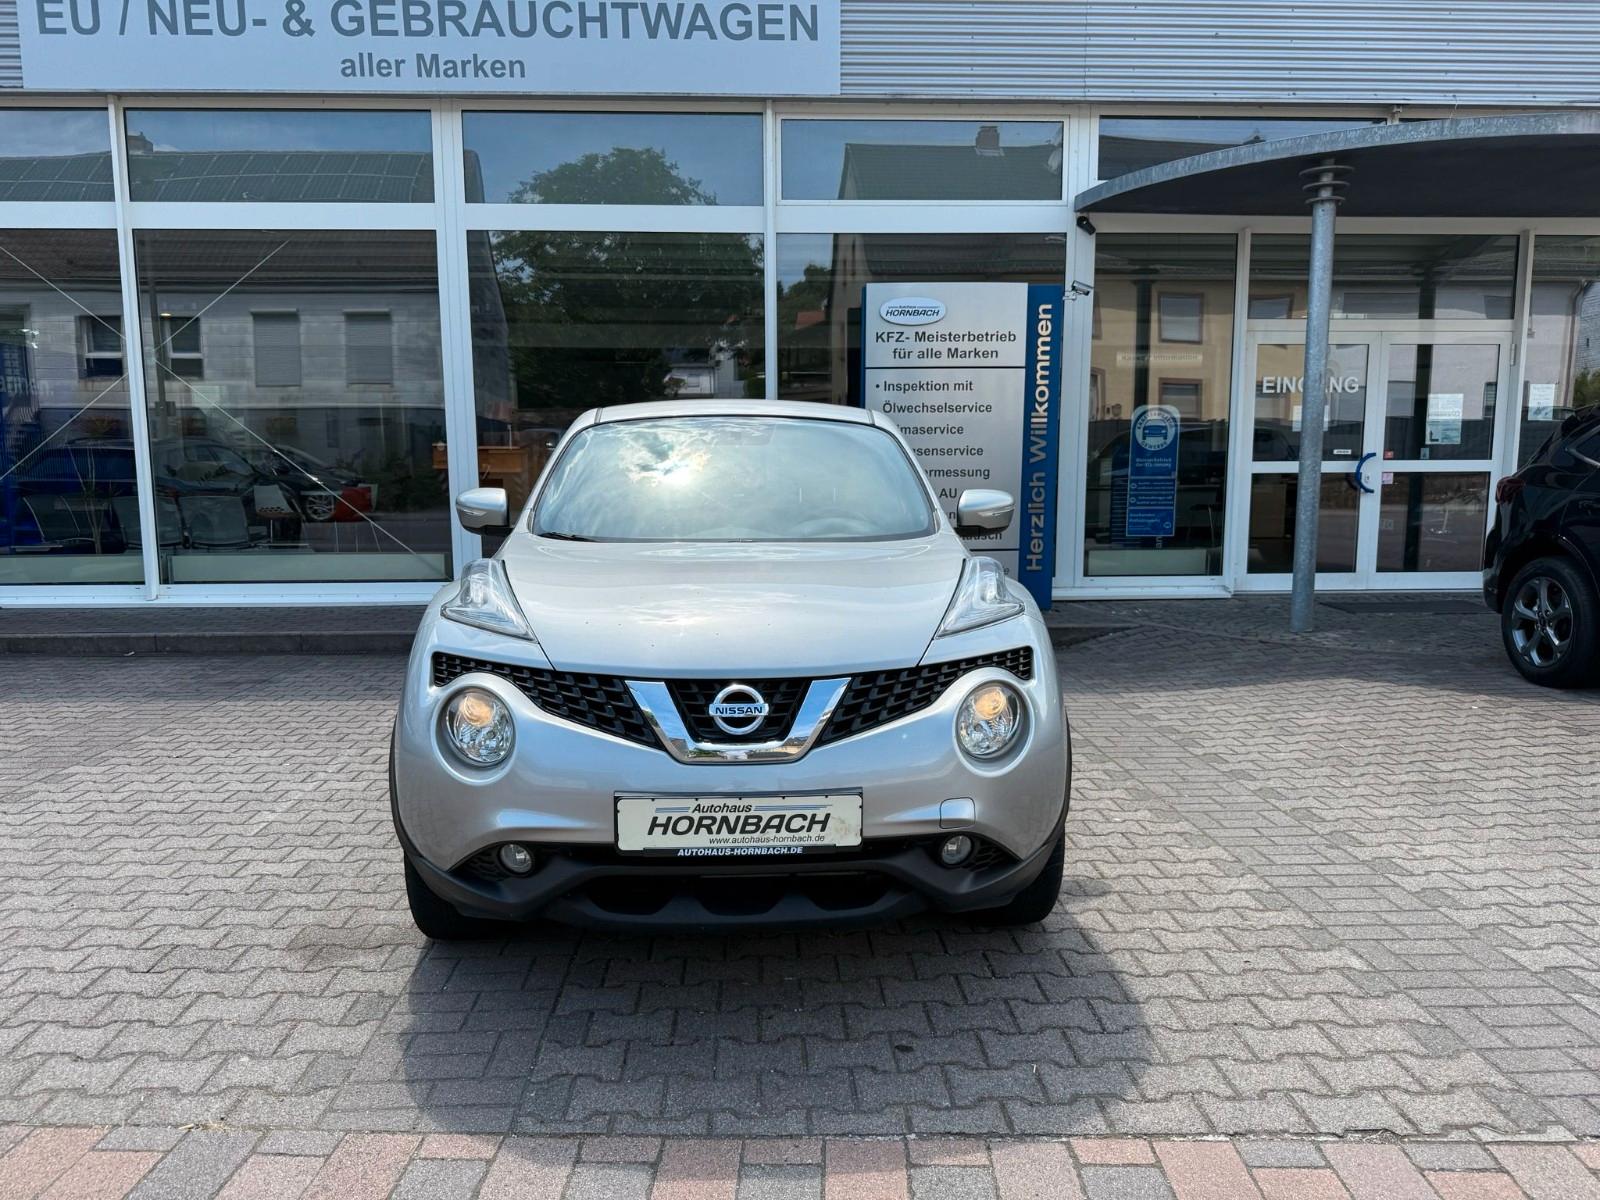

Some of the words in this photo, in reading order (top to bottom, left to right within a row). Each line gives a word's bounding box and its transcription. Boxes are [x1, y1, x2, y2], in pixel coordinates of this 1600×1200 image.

[36, 0, 101, 35] EU
[118, 0, 129, 36] /
[147, 0, 267, 36] NEU-
[281, 0, 316, 37] &
[330, 0, 819, 41] GEBRAUCHTWAGEN
[340, 52, 406, 78] aller
[416, 52, 526, 79] Marken
[885, 309, 940, 317] HORNBACH
[875, 331, 910, 343] KFZ-
[914, 330, 1017, 343] Meisterbetrieb
[892, 347, 913, 359] für
[917, 347, 942, 359] alle
[946, 347, 999, 359] Marken
[883, 380, 950, 394] Inspektion
[953, 380, 974, 392] mit
[1029, 303, 1053, 464] Willkommen
[1262, 376, 1359, 393] EINNG
[882, 402, 993, 414] Ölwechselservice
[897, 424, 964, 435] maservice
[913, 445, 984, 456] senservice
[939, 487, 958, 499] AU
[1026, 471, 1046, 571] Herzlich
[715, 705, 763, 715] NISSAN
[691, 803, 753, 814] Autohaus
[647, 812, 831, 836] HORNBACH
[708, 834, 826, 845] www.autohaus-hornbach.de
[677, 846, 804, 857] AUTOHAUS-HORNBACH.DE
